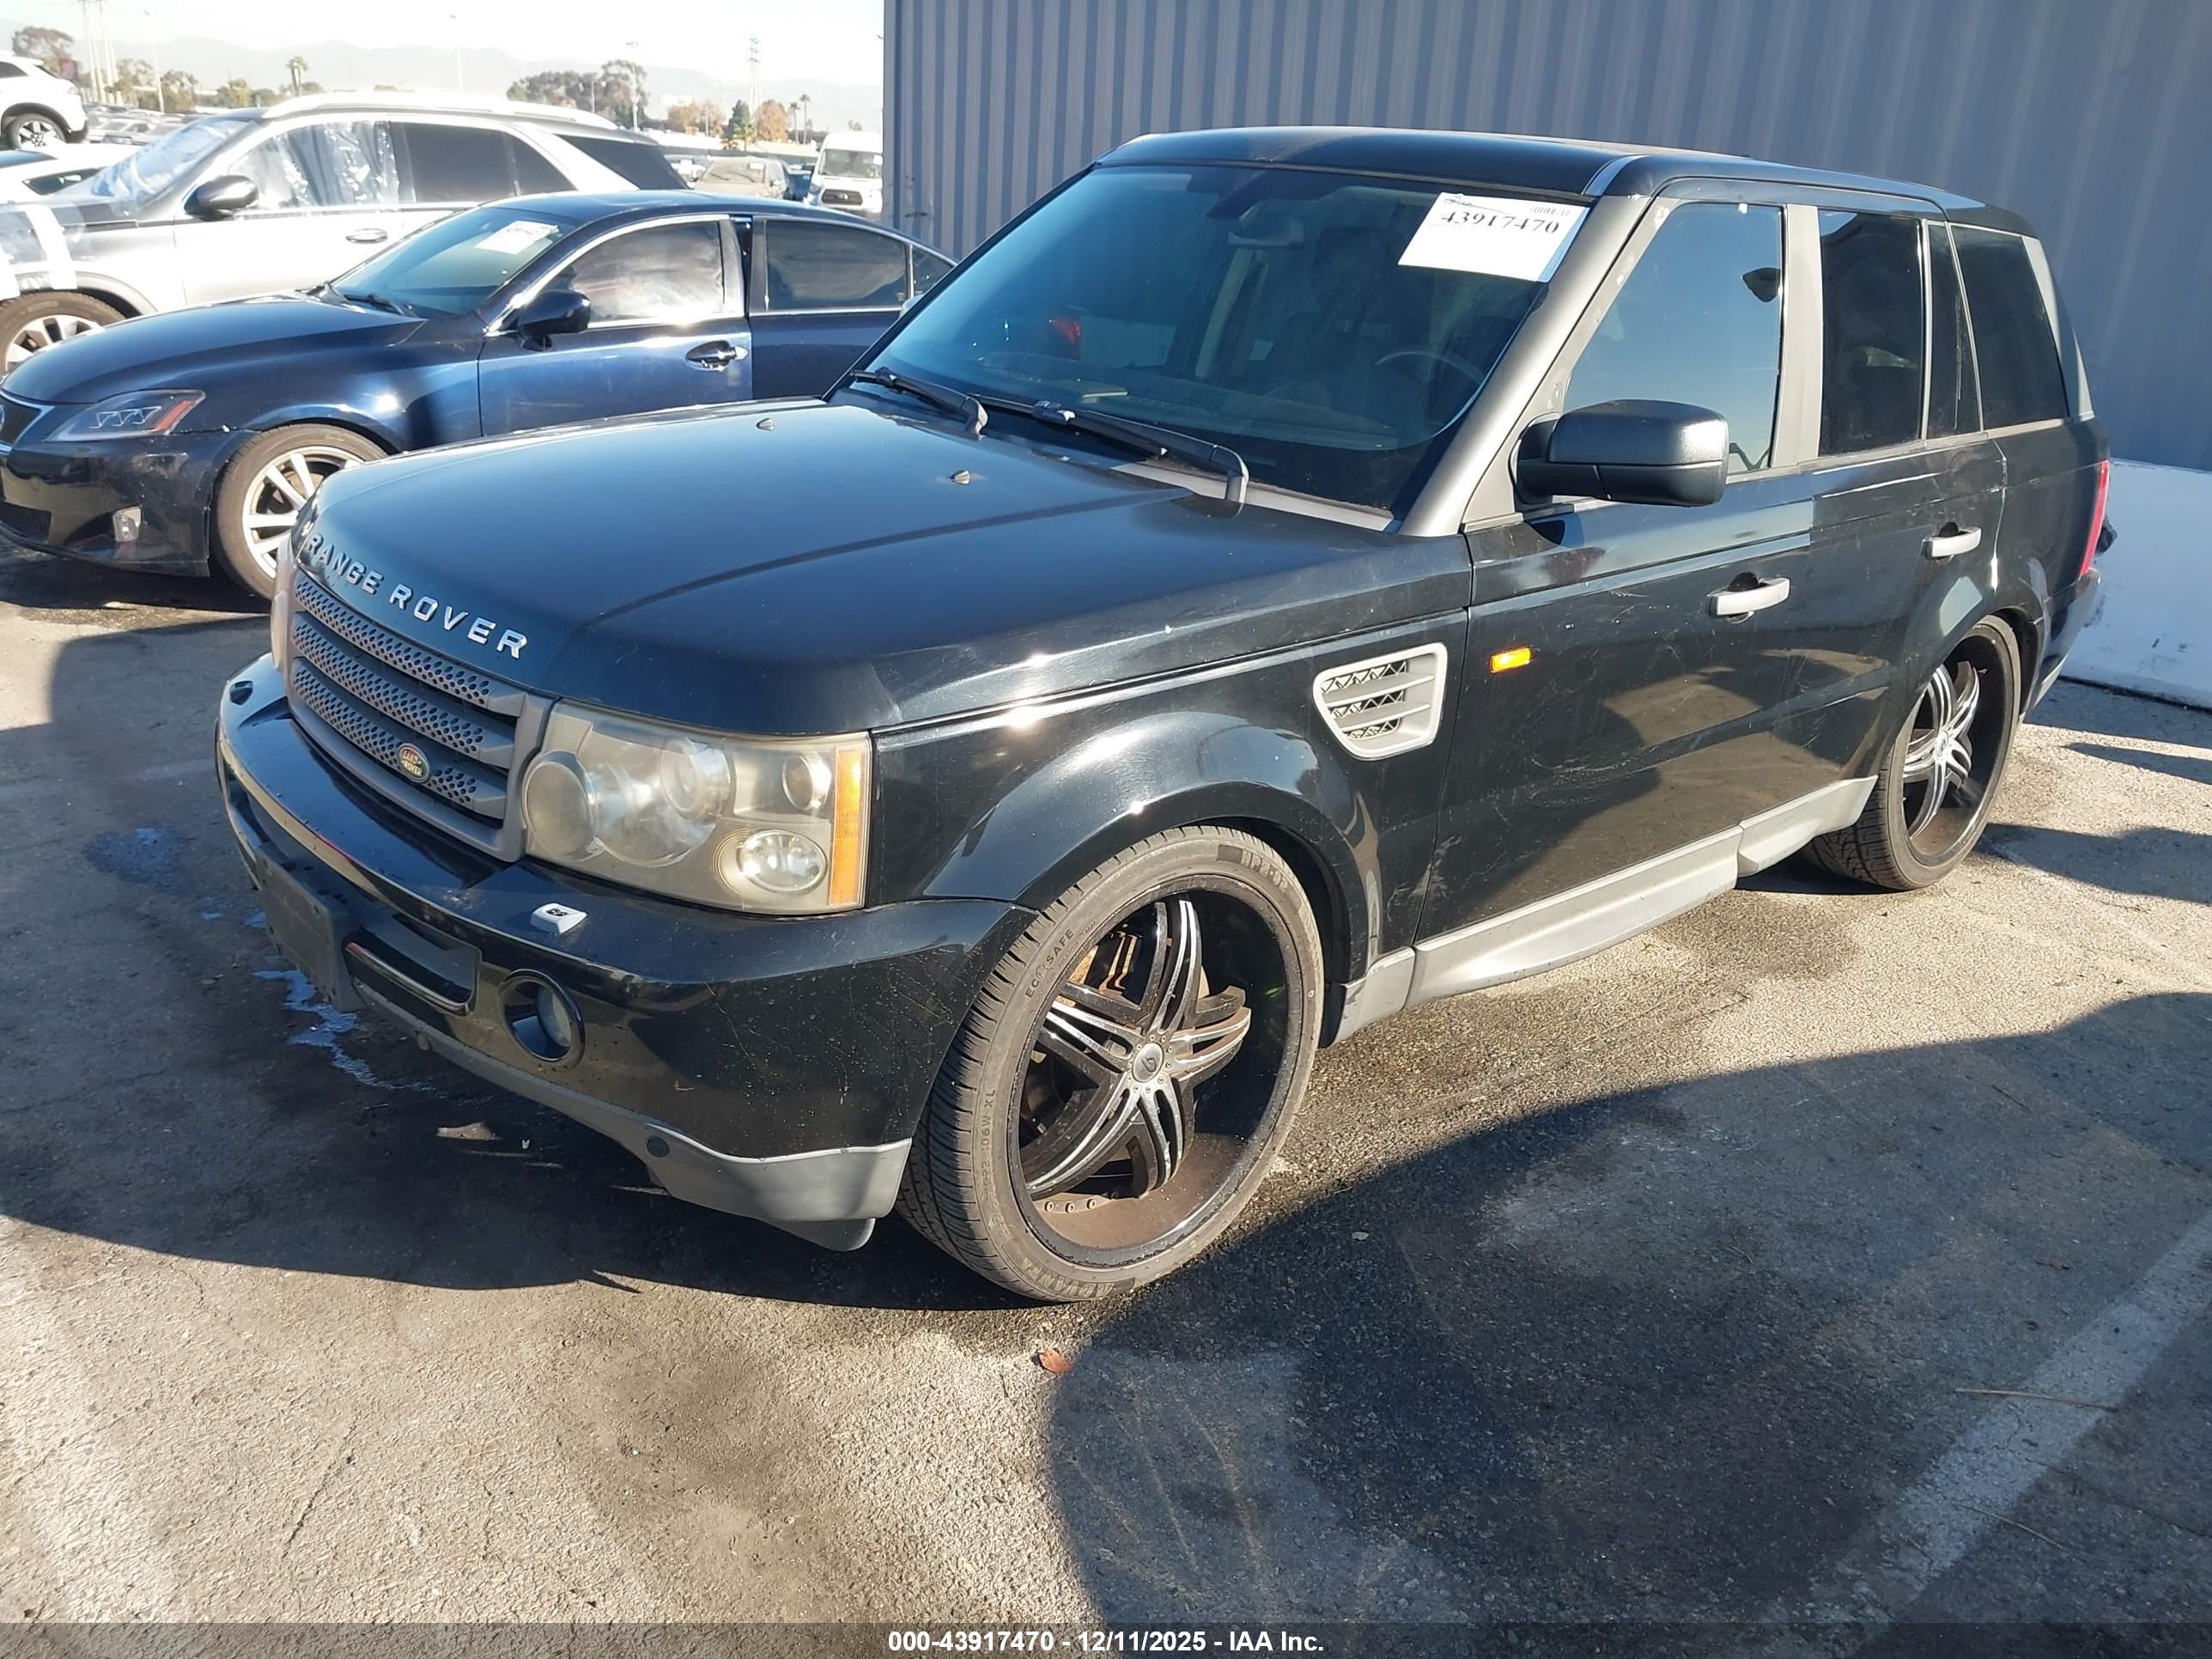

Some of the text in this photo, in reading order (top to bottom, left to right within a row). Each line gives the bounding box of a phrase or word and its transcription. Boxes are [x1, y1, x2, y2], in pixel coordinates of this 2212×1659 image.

[1441, 211, 1559, 234] 43917470
[308, 533, 528, 659] RANGE ROVER
[404, 762, 423, 777] ROVER
